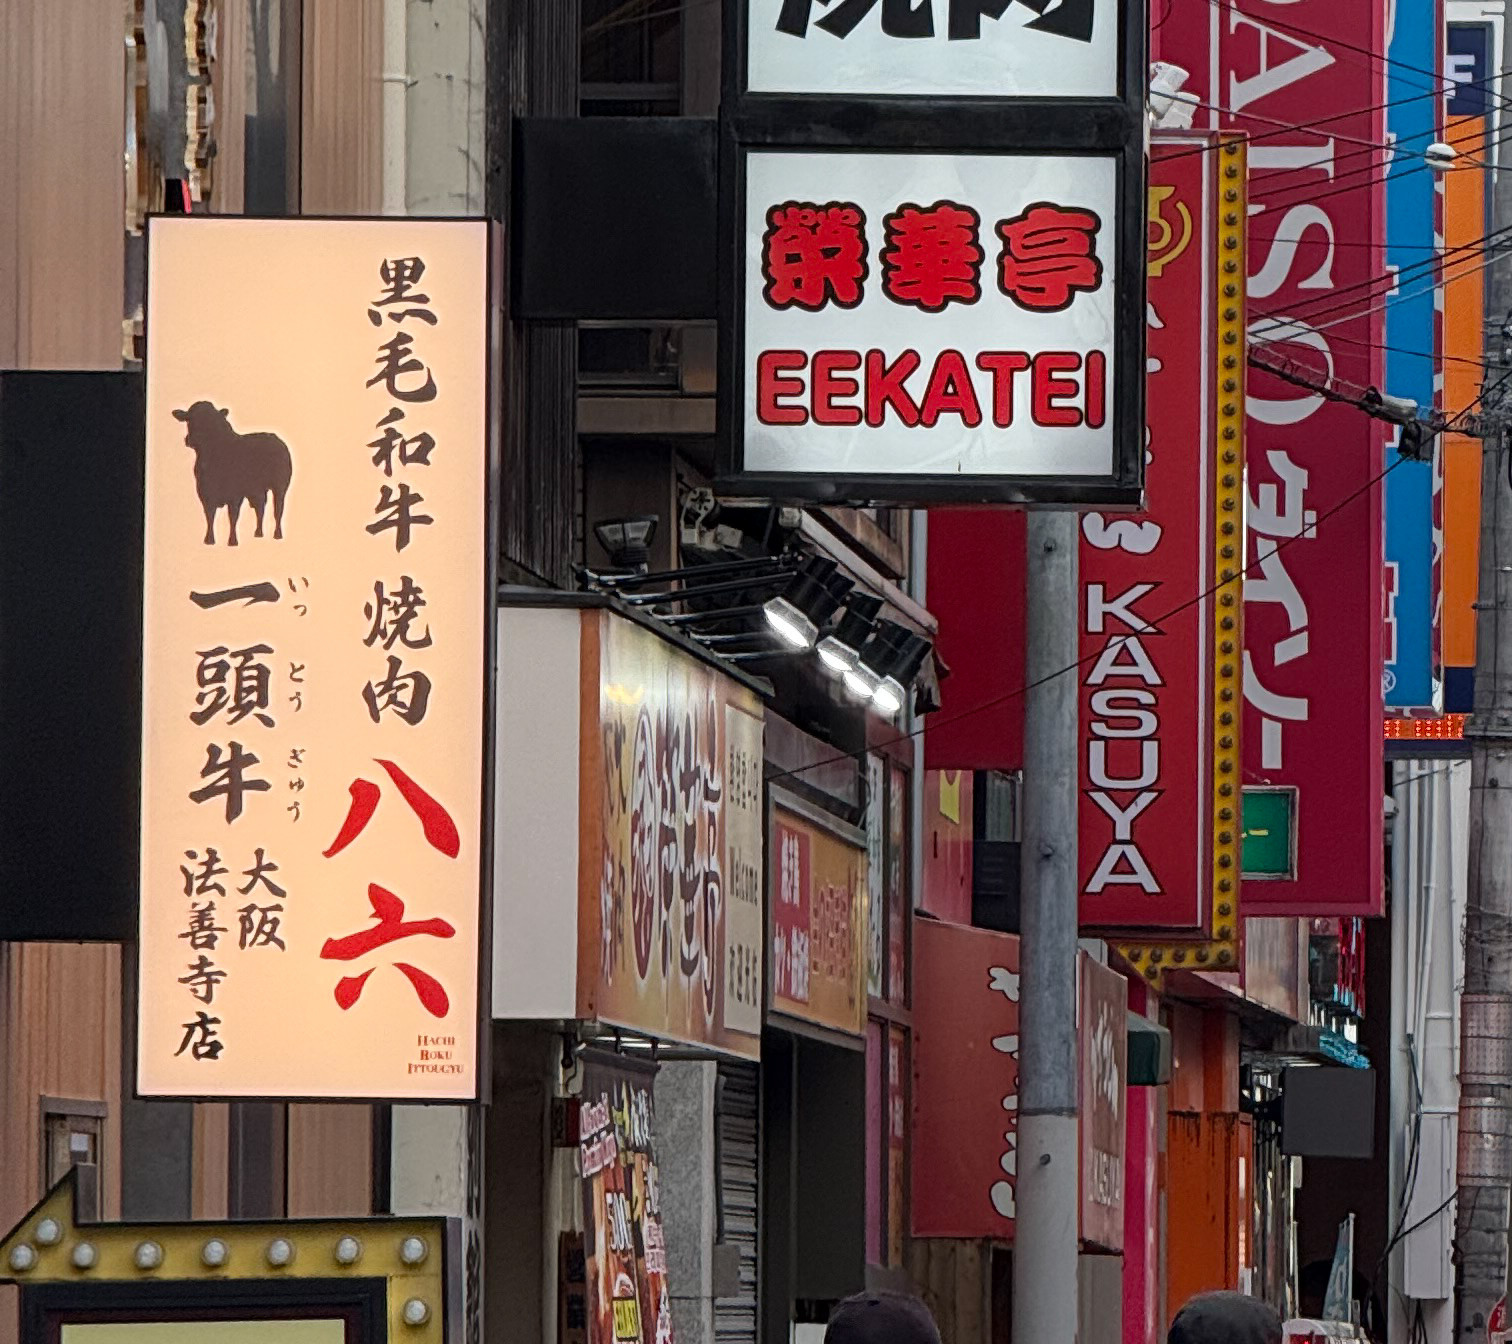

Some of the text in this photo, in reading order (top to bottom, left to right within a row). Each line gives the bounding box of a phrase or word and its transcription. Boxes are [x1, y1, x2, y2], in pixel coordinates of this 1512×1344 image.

[361, 257, 438, 726] 黒毛和牛 焼肉
[756, 348, 1107, 429] EEKATEI
[189, 581, 281, 825] 一頭牛
[288, 660, 306, 713] とう
[1244, 449, 1318, 771] ダイソー
[1084, 582, 1164, 896] KASUYA
[174, 847, 230, 1062] 法善寺店
[237, 847, 287, 952] 大阪
[320, 758, 461, 1019] 八六
[420, 1049, 453, 1061] ROKU
